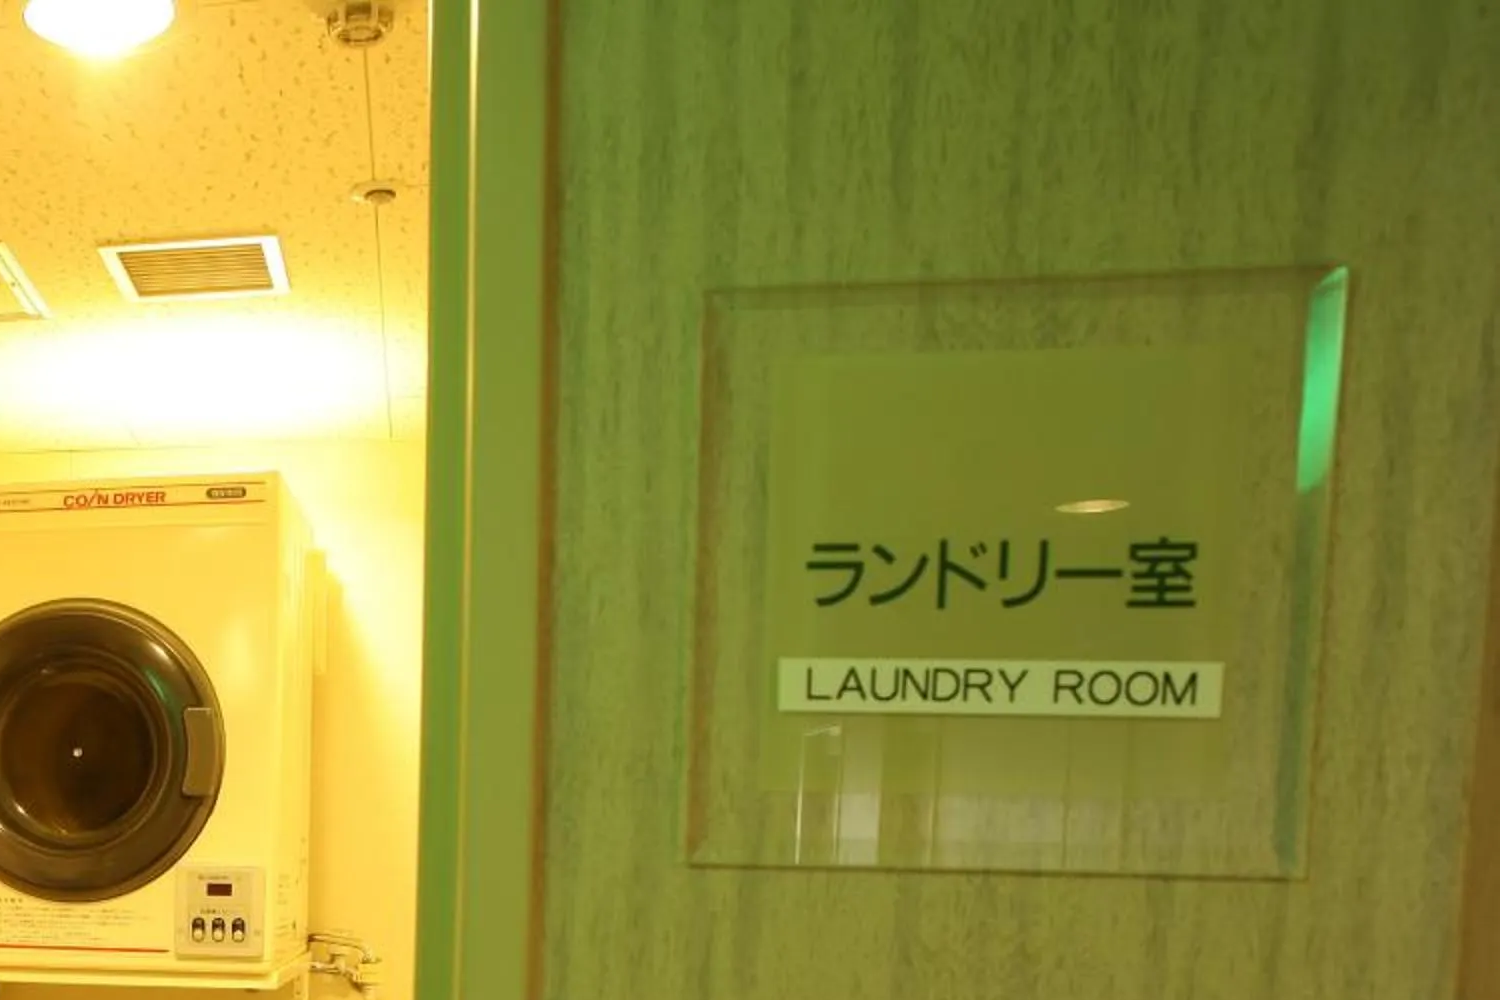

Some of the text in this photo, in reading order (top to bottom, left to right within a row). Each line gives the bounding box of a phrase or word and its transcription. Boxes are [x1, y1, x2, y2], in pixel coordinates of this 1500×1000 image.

[113, 491, 167, 505] DRYER
[806, 537, 1198, 609] ランドリー室
[807, 667, 1198, 706] LAUNDRY ROOM
